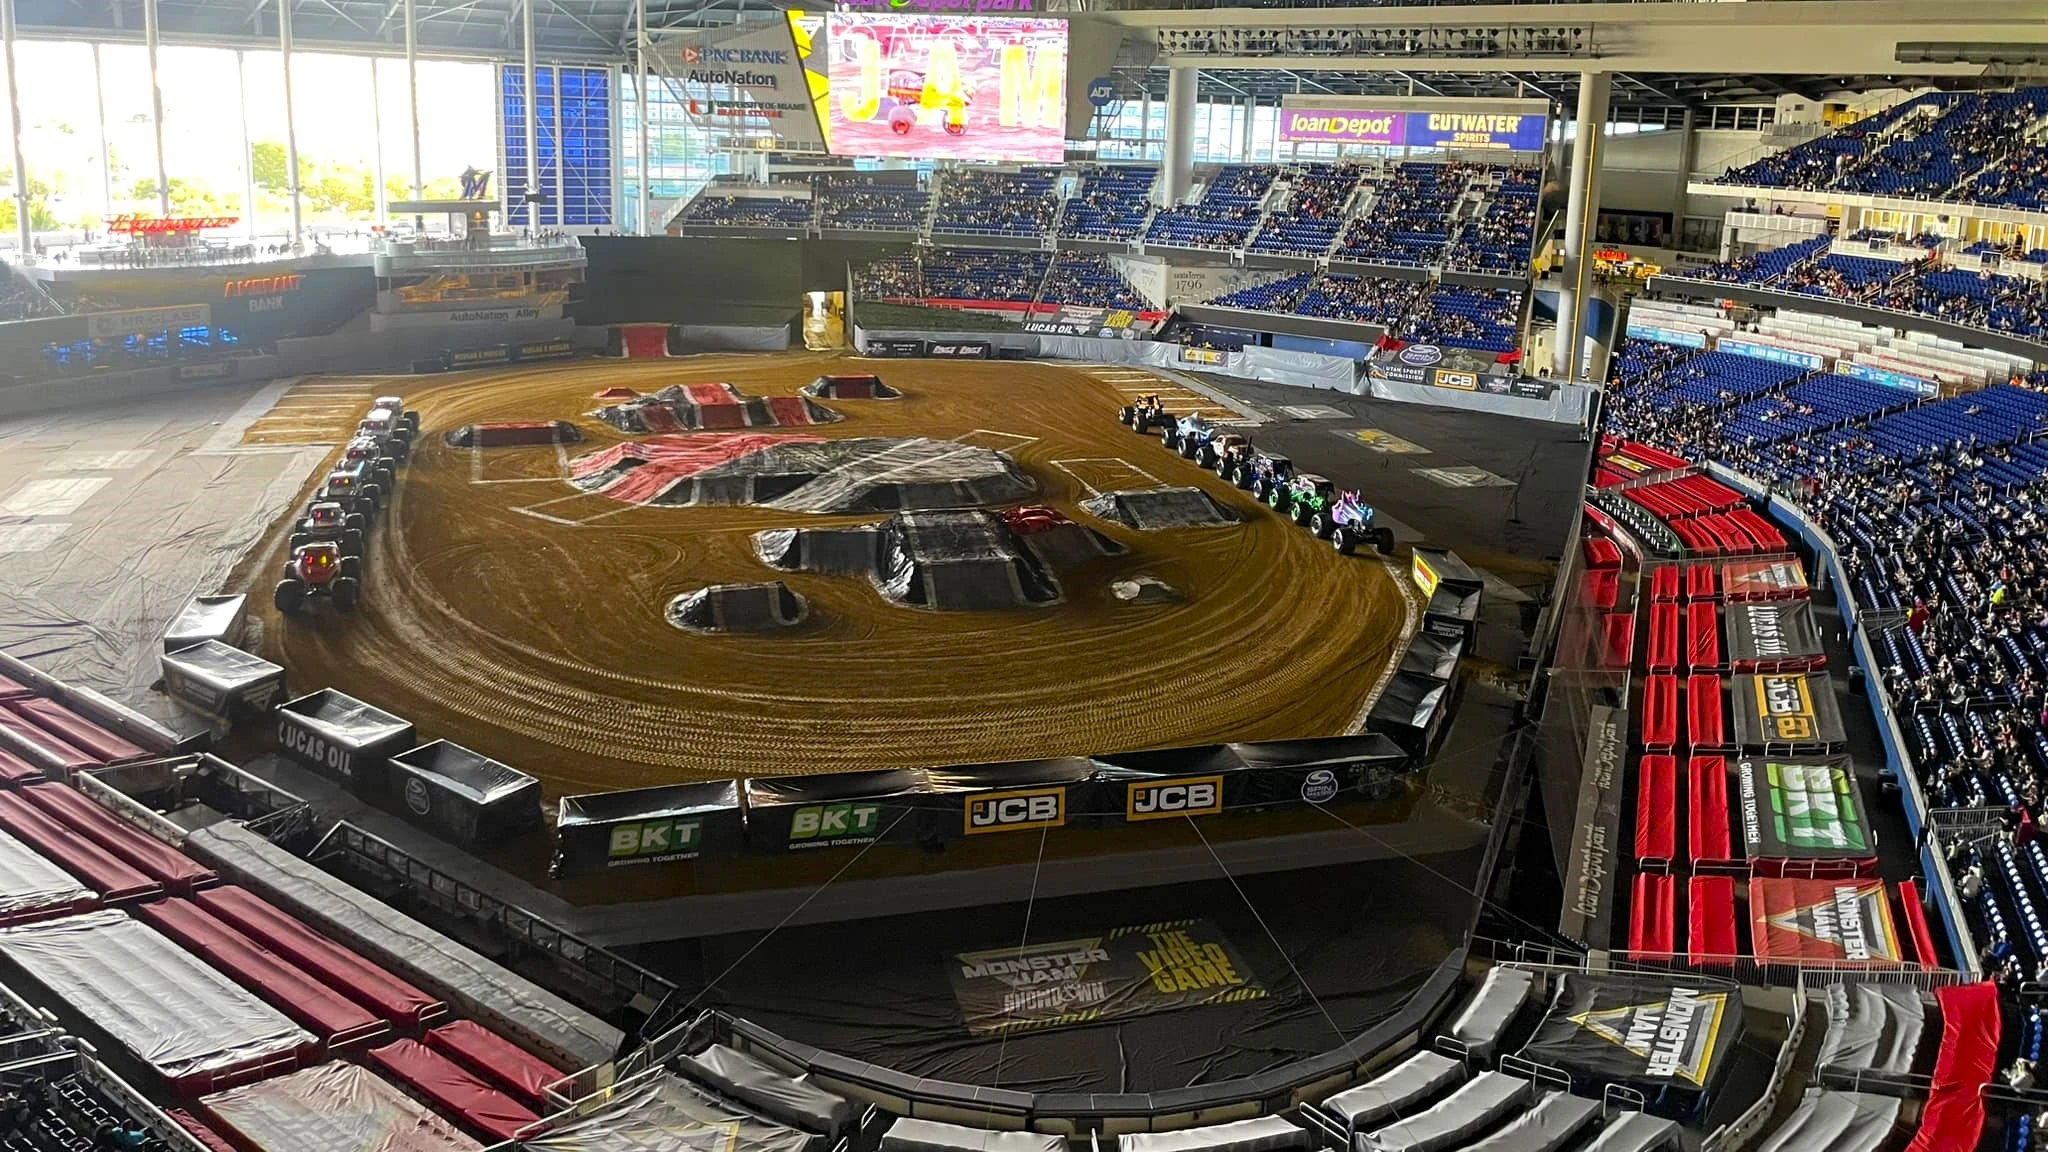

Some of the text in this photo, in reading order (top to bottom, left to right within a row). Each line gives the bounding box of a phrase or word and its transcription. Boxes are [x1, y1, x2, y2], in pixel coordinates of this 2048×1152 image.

[702, 48, 788, 64] PNC BANK
[688, 69, 777, 88] AutoNation
[839, 36, 1063, 127] JAM
[1090, 87, 1112, 98] ADT
[1290, 114, 1392, 137] loanDepot
[1429, 114, 1518, 133] CUTWATER
[1453, 132, 1491, 142] SPIRITS
[1176, 280, 1202, 291] 1796
[249, 296, 284, 313] BANK
[450, 308, 540, 322] AutoNation Alley
[149, 310, 201, 324] GLASS
[1025, 322, 1073, 334] LUCAS OIL
[1386, 372, 1424, 381] COMMISSION
[1403, 368, 1424, 376] SPORTS
[1439, 374, 1473, 386] JCB
[1747, 605, 1785, 638] LUCAS
[1754, 638, 1790, 657] OIL
[1766, 679, 1800, 713] JCB
[278, 720, 352, 775] LUCAS OIL
[1135, 784, 1215, 812] JCB
[1740, 763, 1762, 844] GROWING TOGETHER
[1781, 765, 1848, 847] BKT
[793, 807, 878, 833] BKT
[973, 796, 1057, 826] JCB
[611, 823, 700, 850] BKT
[789, 837, 875, 850] GROWING TOGETHER
[1583, 823, 1610, 852] park
[608, 852, 699, 867] GROWING TOGETHER
[1811, 905, 1840, 938] JAM
[1834, 886, 1871, 960] MONSTER
[1147, 931, 1196, 951] THE
[961, 949, 1111, 979] MONSTER
[1136, 943, 1230, 973] VIDEO
[1015, 965, 1079, 986] JAM
[1153, 961, 1243, 992] GAME
[1003, 981, 1106, 1012] SHOWDOWN
[1624, 1007, 1661, 1048] JAM
[1645, 987, 1700, 1077] MONSTER
